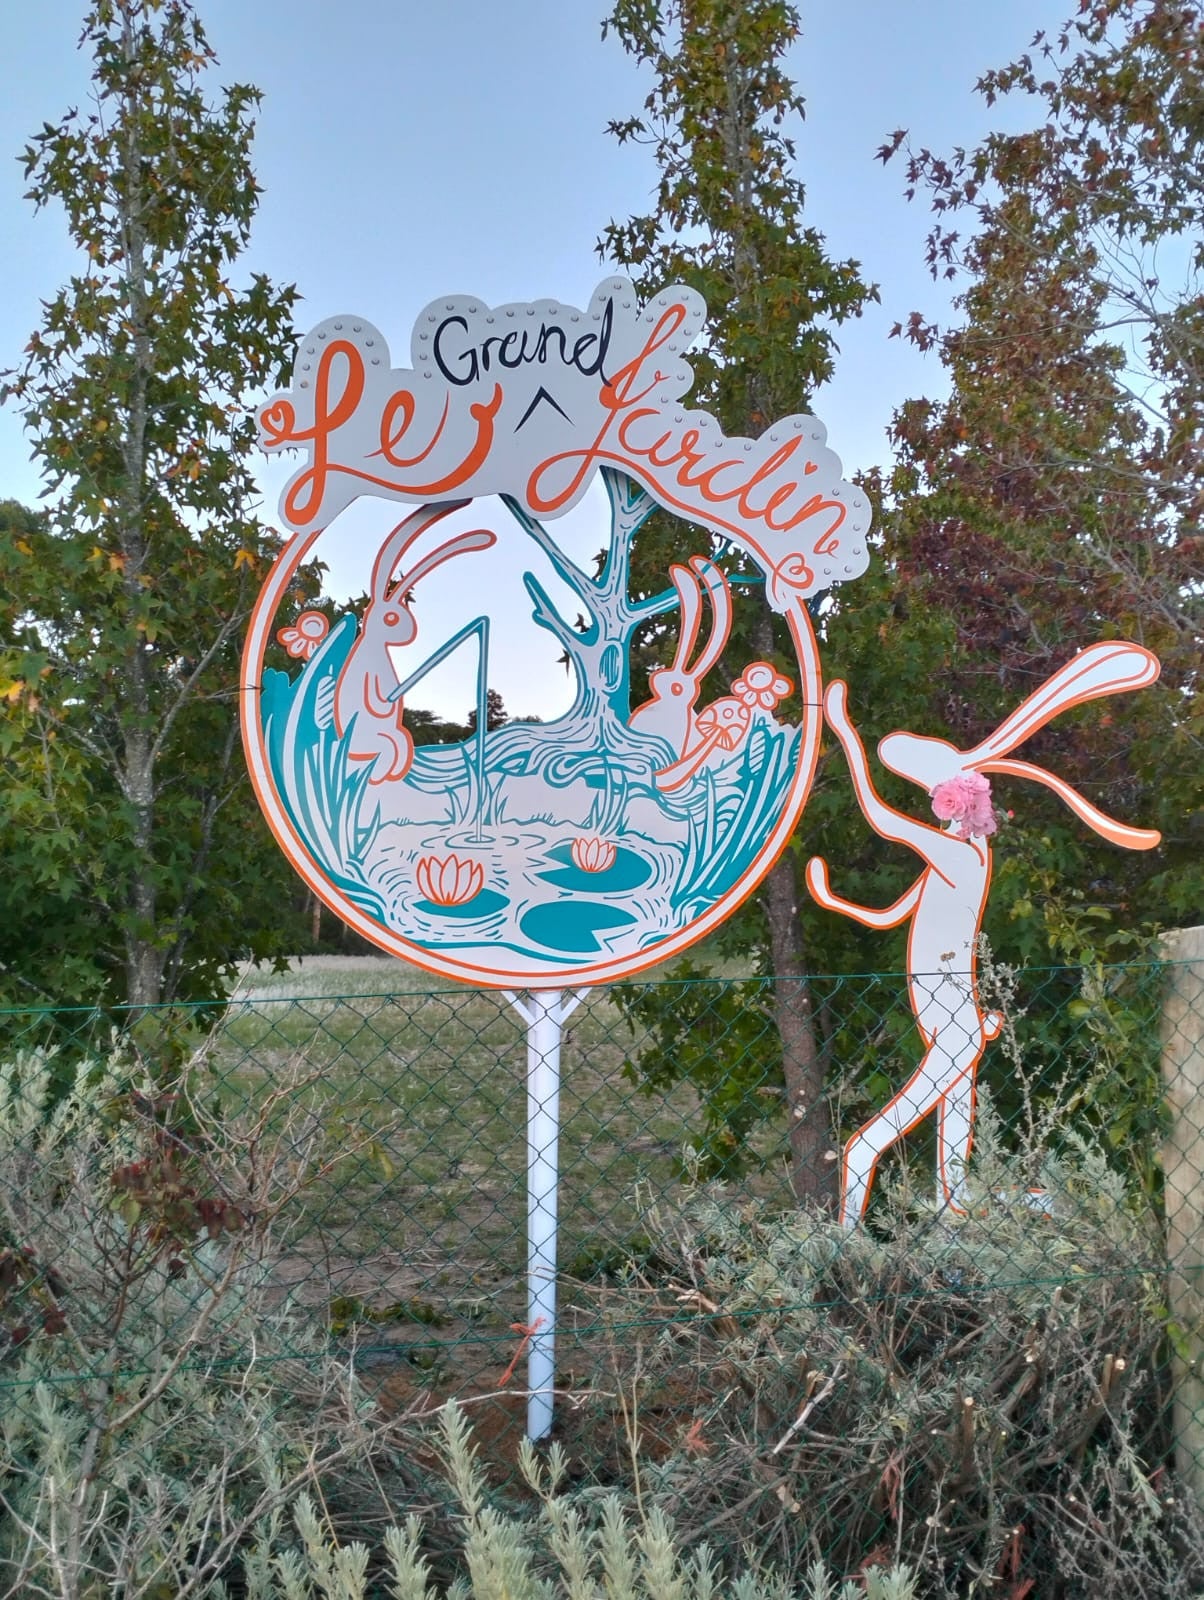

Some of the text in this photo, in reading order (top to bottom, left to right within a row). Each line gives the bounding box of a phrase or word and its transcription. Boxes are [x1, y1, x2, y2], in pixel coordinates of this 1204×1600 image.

[258, 296, 848, 590] Le Grand Jardin
